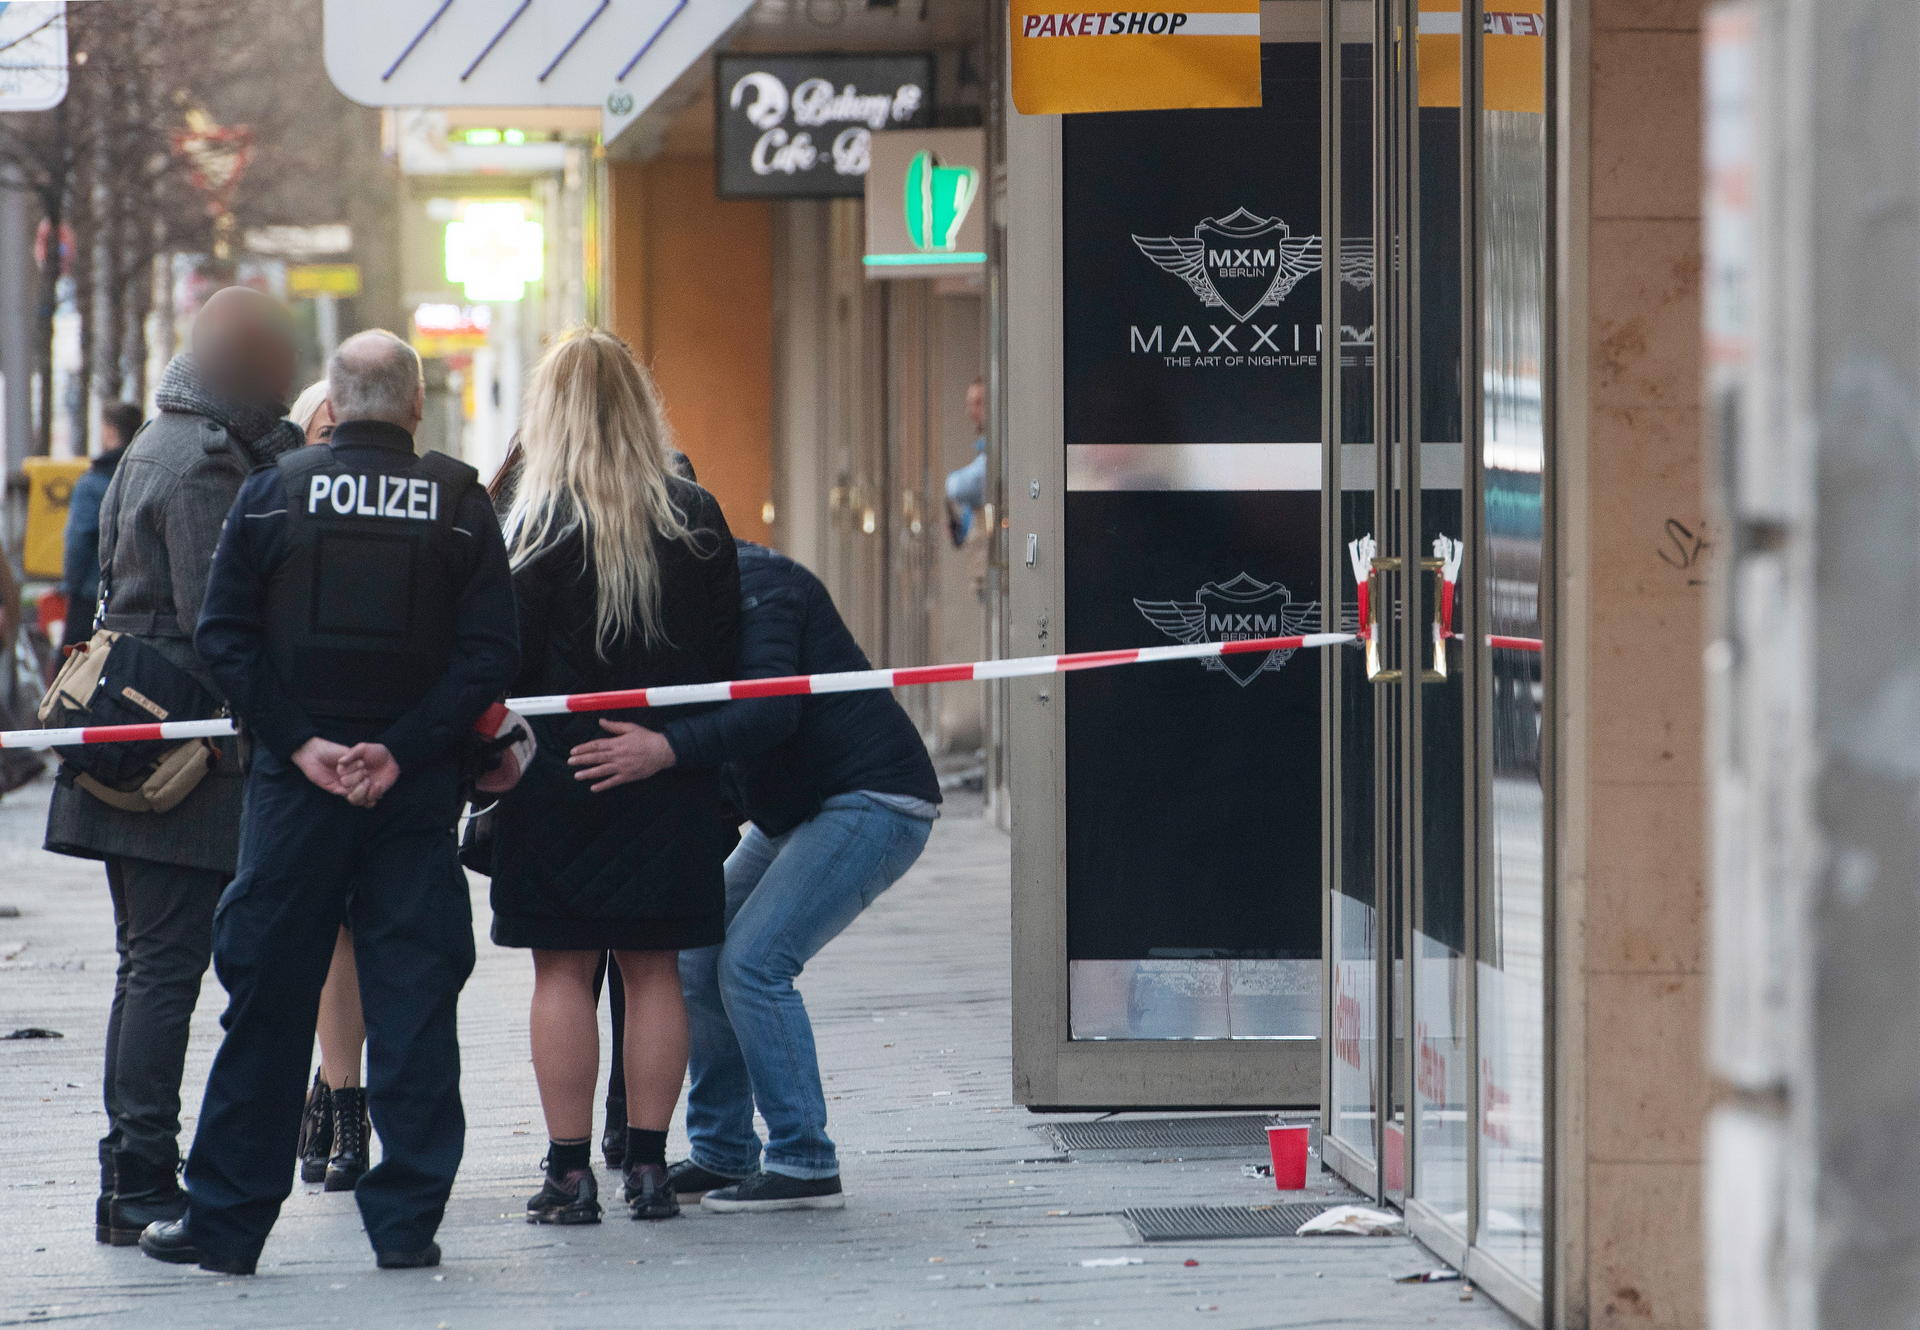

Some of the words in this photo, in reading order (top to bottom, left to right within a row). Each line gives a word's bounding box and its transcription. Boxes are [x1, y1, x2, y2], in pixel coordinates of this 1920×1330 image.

[1023, 12, 1188, 38] PAKETSHOP
[832, 126, 871, 176] B
[1208, 249, 1276, 267] MXM
[1219, 267, 1266, 278] BERLIN
[1130, 324, 1323, 353] MAXXI
[1164, 355, 1192, 368] THE
[1194, 355, 1222, 368] ART
[1225, 355, 1244, 368] OF
[1247, 355, 1317, 368] NIGHTLIFE
[308, 474, 438, 519] POLIZEI
[1210, 614, 1277, 632] MXM
